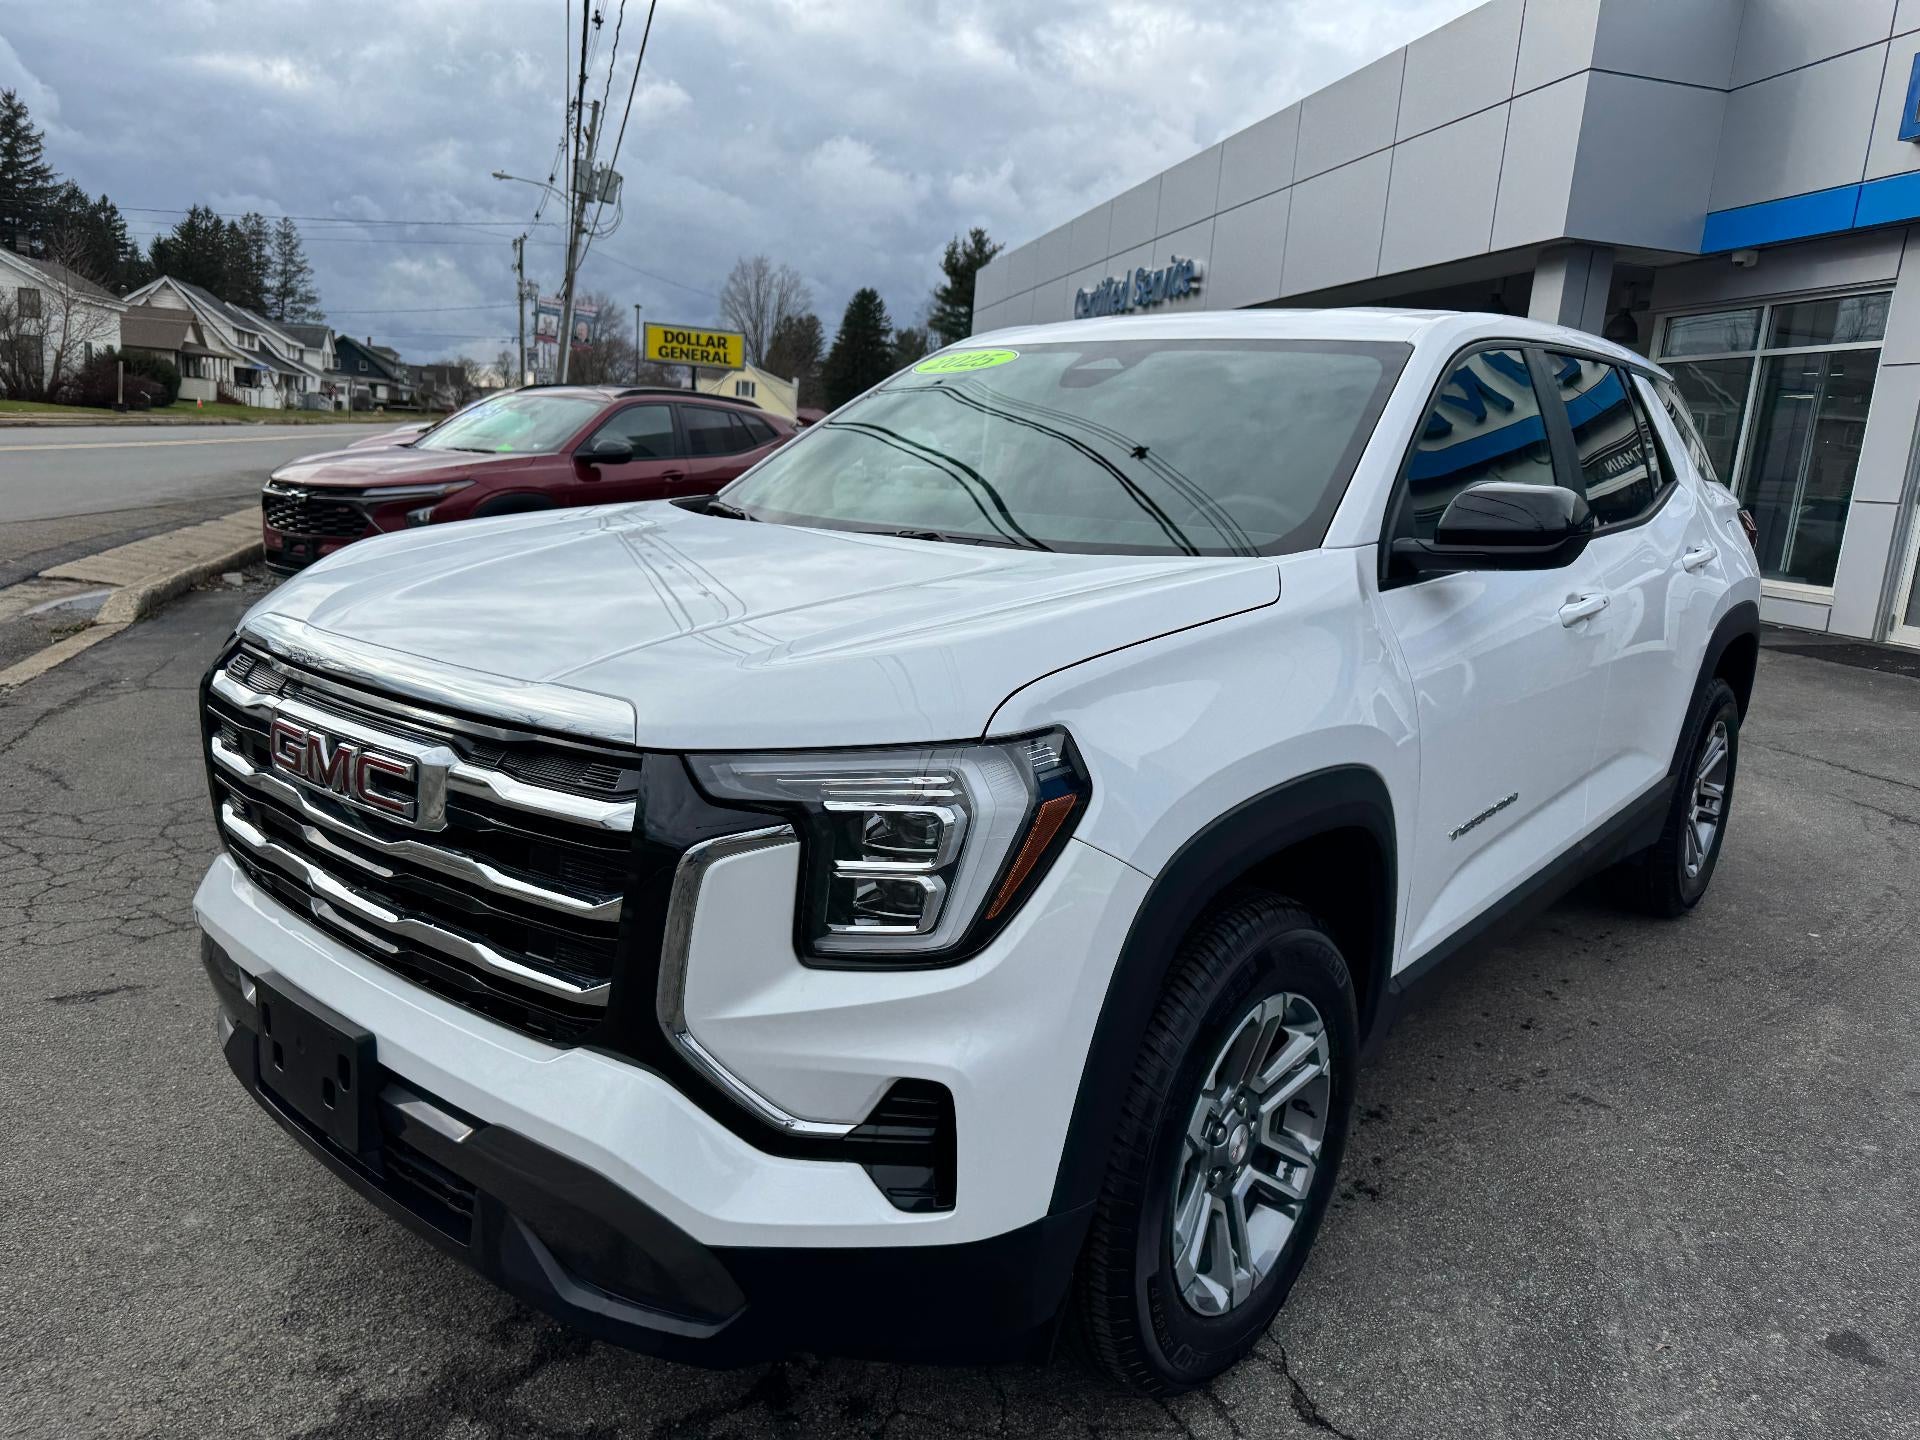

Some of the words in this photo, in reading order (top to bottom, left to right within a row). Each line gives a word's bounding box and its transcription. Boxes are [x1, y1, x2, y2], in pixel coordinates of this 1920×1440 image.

[1133, 254, 1198, 306] Service
[658, 345, 732, 364] GENERAL
[663, 330, 728, 350] DOLLAR
[270, 717, 416, 818] GMC
